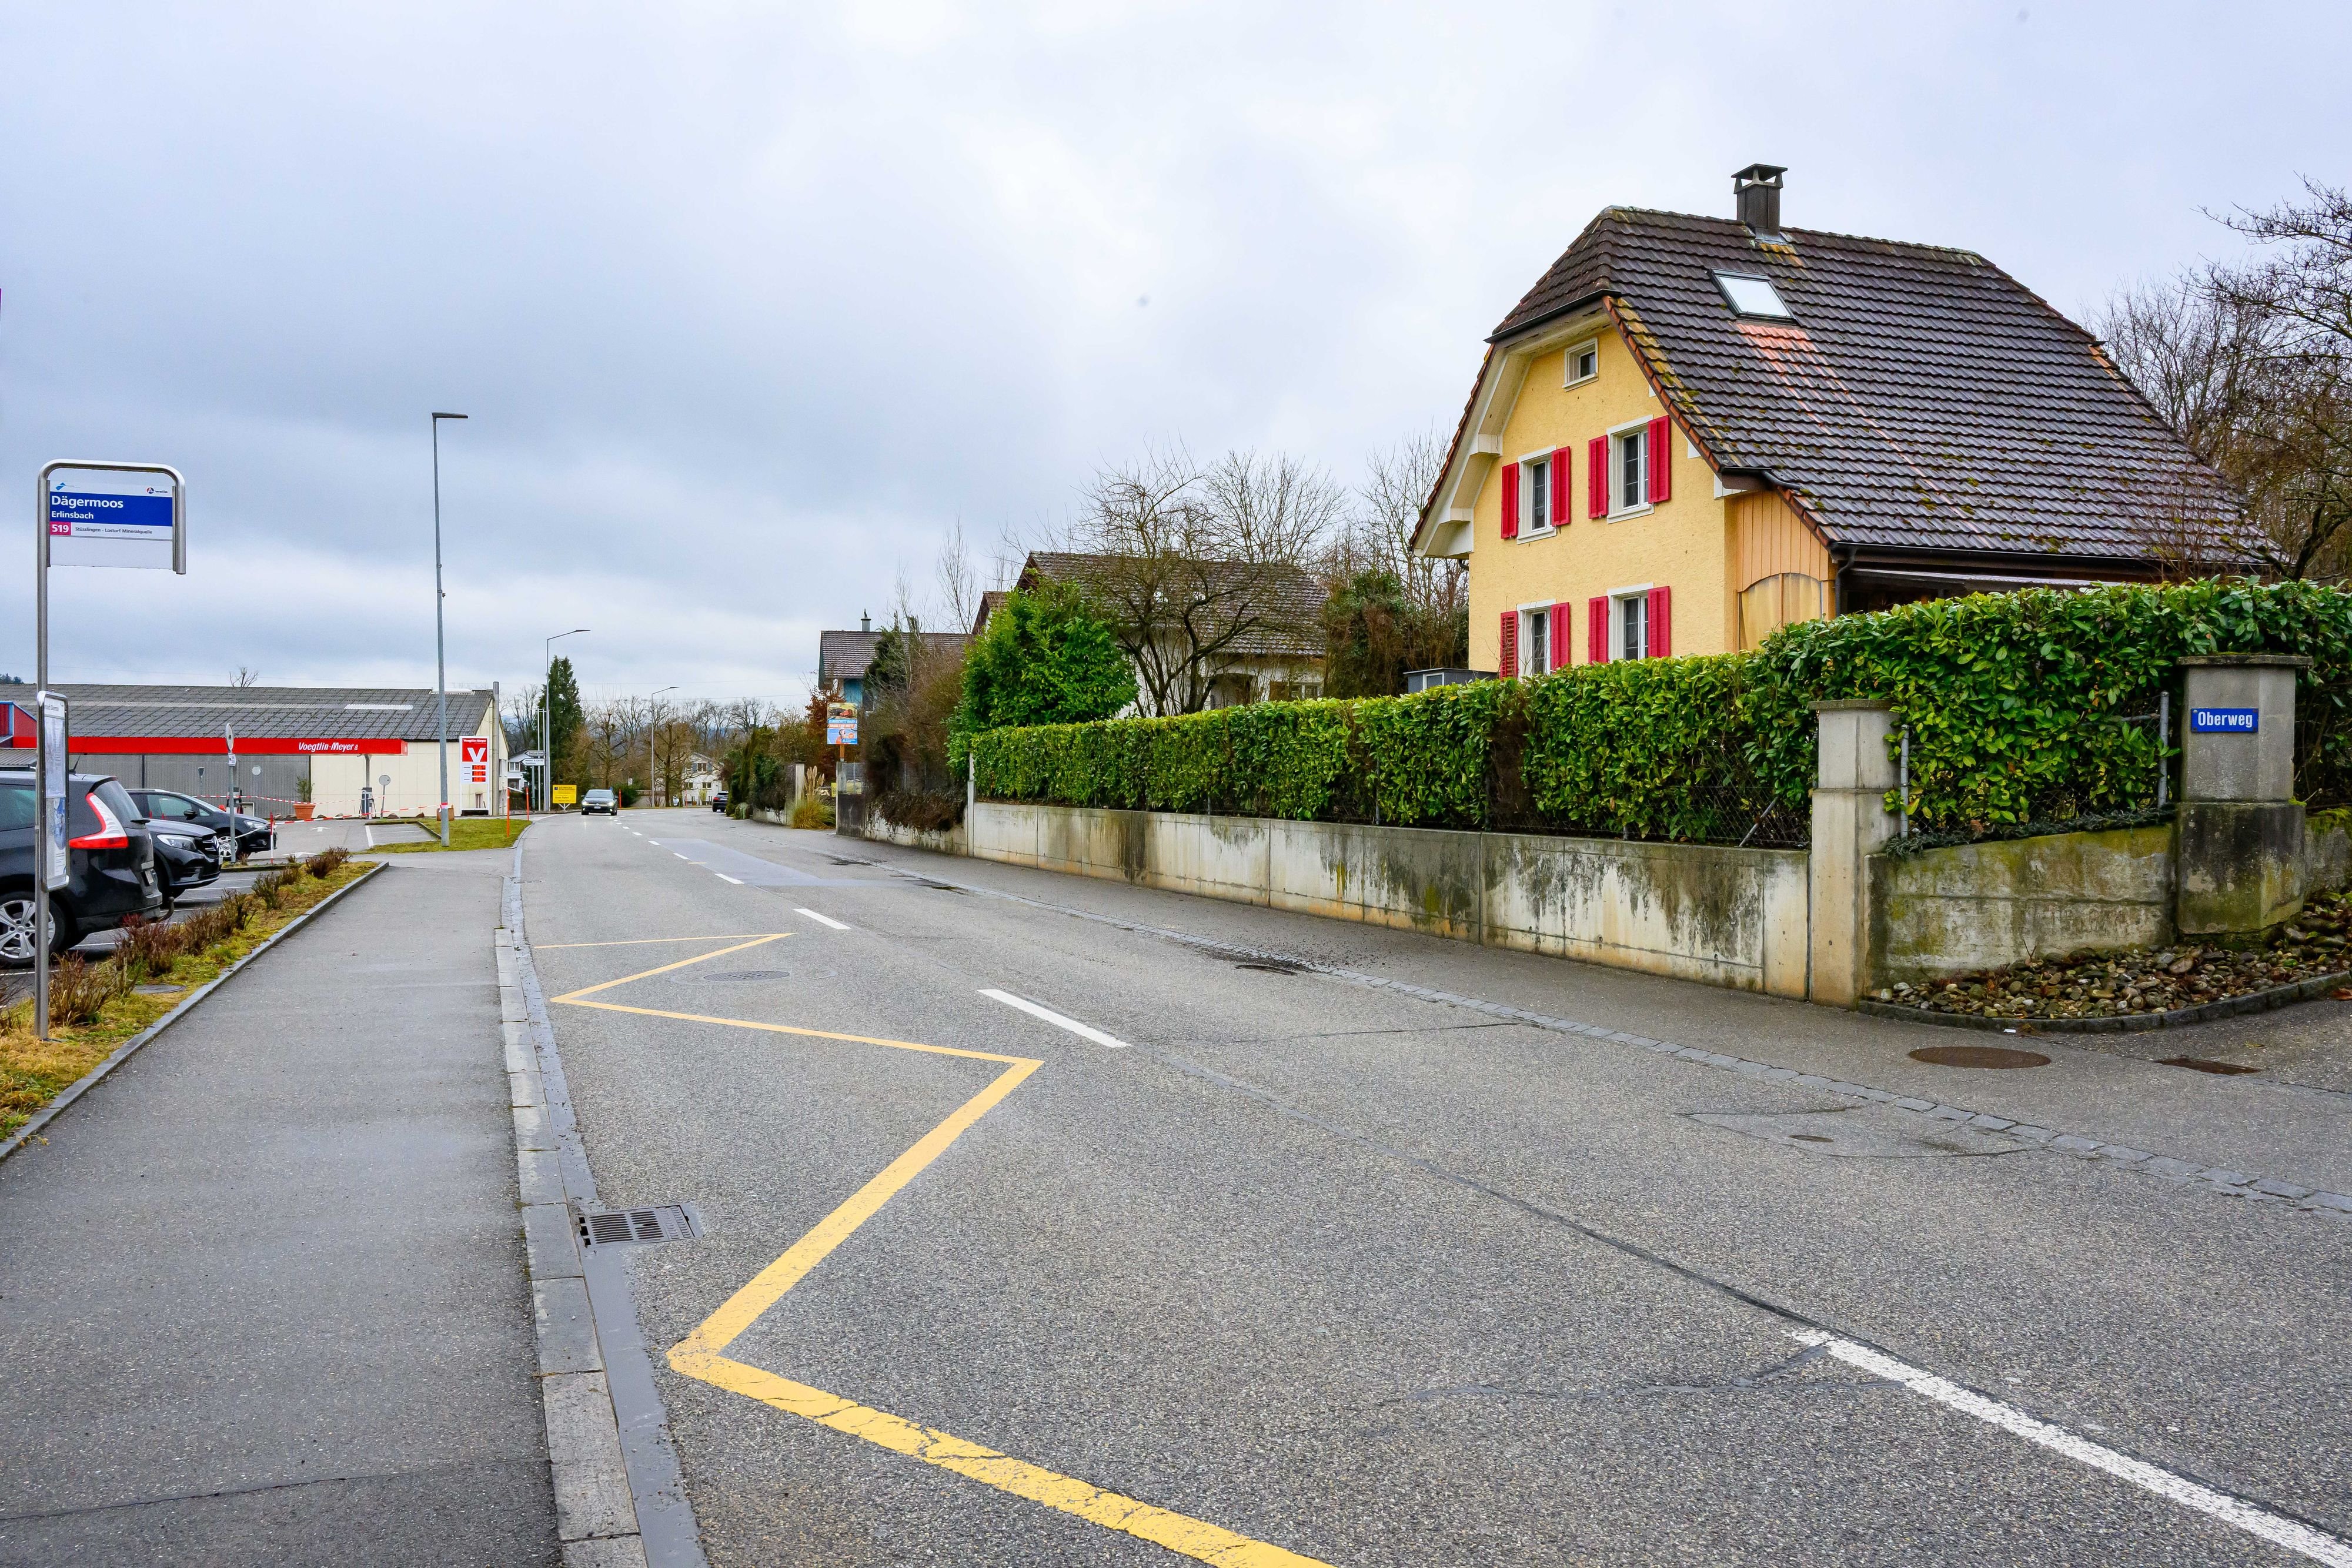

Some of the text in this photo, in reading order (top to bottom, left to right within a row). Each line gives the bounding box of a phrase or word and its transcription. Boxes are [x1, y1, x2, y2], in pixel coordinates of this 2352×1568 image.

[51, 496, 123, 509] Dägermoos
[51, 511, 94, 519] Erlinsbach
[52, 524, 69, 533] 519
[2197, 711, 2253, 728] Oberweg
[299, 742, 354, 753] Voegtlin-Meyer
[467, 747, 486, 762] V
